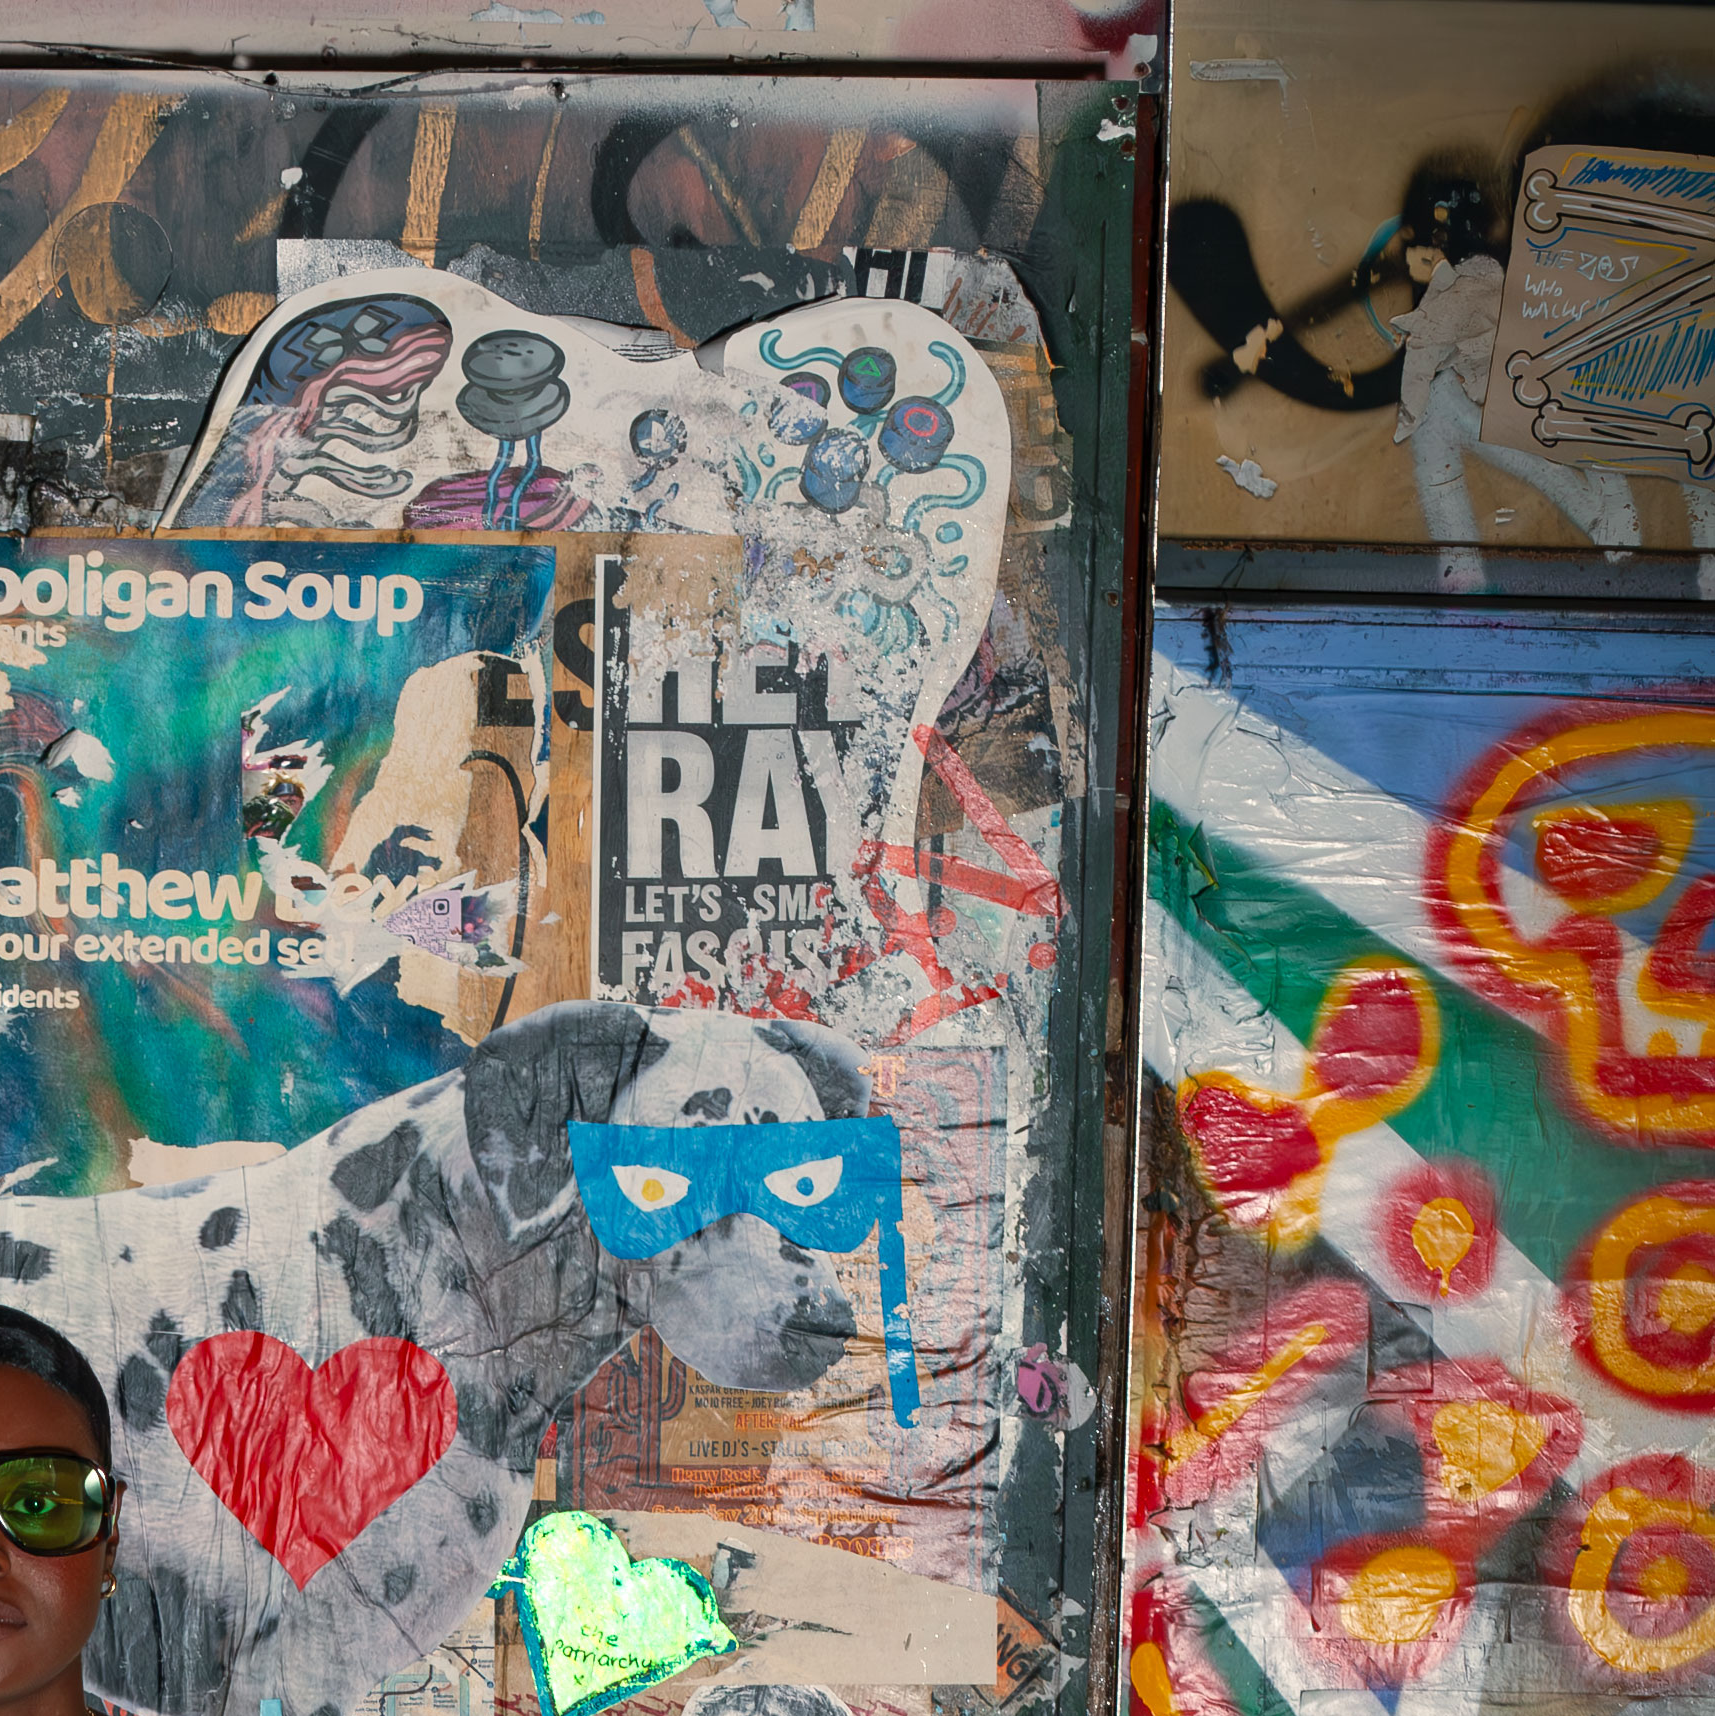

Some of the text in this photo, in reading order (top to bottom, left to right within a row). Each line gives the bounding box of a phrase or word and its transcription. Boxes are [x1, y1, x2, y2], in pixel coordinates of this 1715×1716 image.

[243, 560, 424, 637] Soup
[624, 883, 723, 925] LET'S
[75, 925, 271, 966] extended
[721, 1397, 744, 1409] FREE
[689, 1441, 719, 1458] LIVE
[722, 1439, 750, 1458] DJ'S
[581, 1622, 619, 1648] the
[549, 1637, 655, 1673] patriarchy
